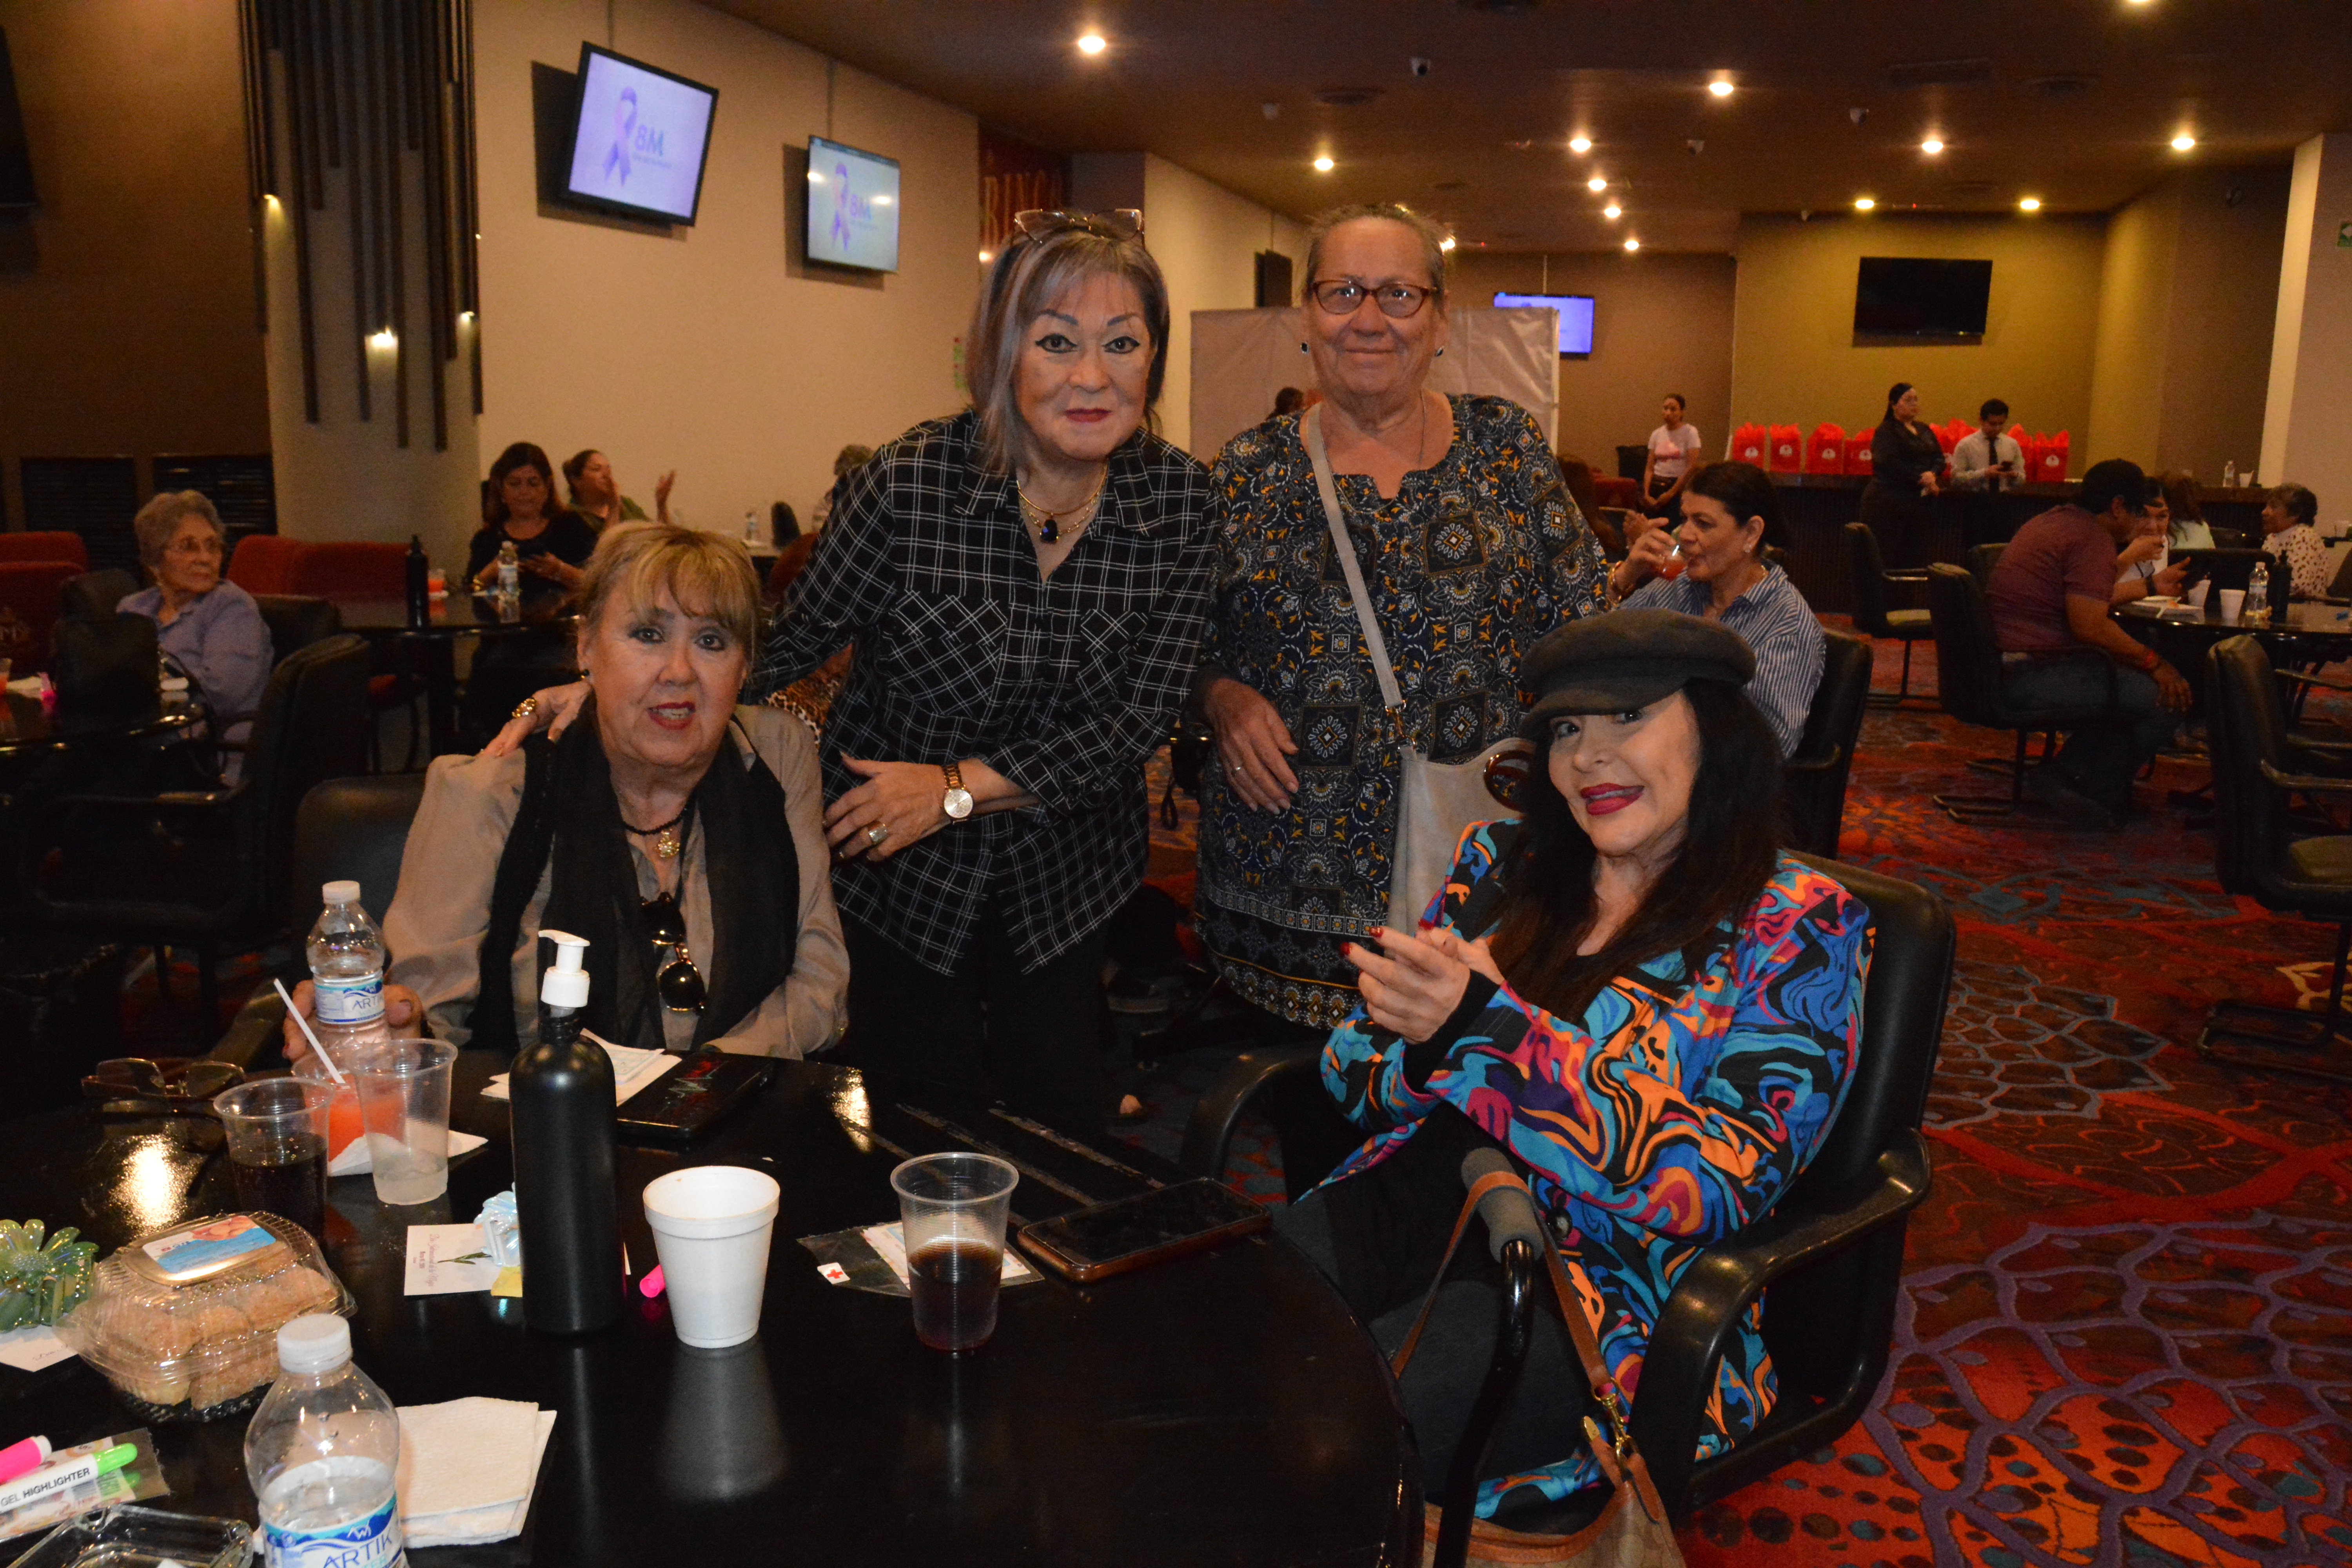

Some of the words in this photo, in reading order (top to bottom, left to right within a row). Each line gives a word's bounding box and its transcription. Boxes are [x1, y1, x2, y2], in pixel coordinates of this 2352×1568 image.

[634, 124, 664, 157] 8M
[1, 1493, 21, 1506] GEL
[23, 1467, 90, 1498] HIGHLIGHTER
[323, 1527, 392, 1568] ARTIK
